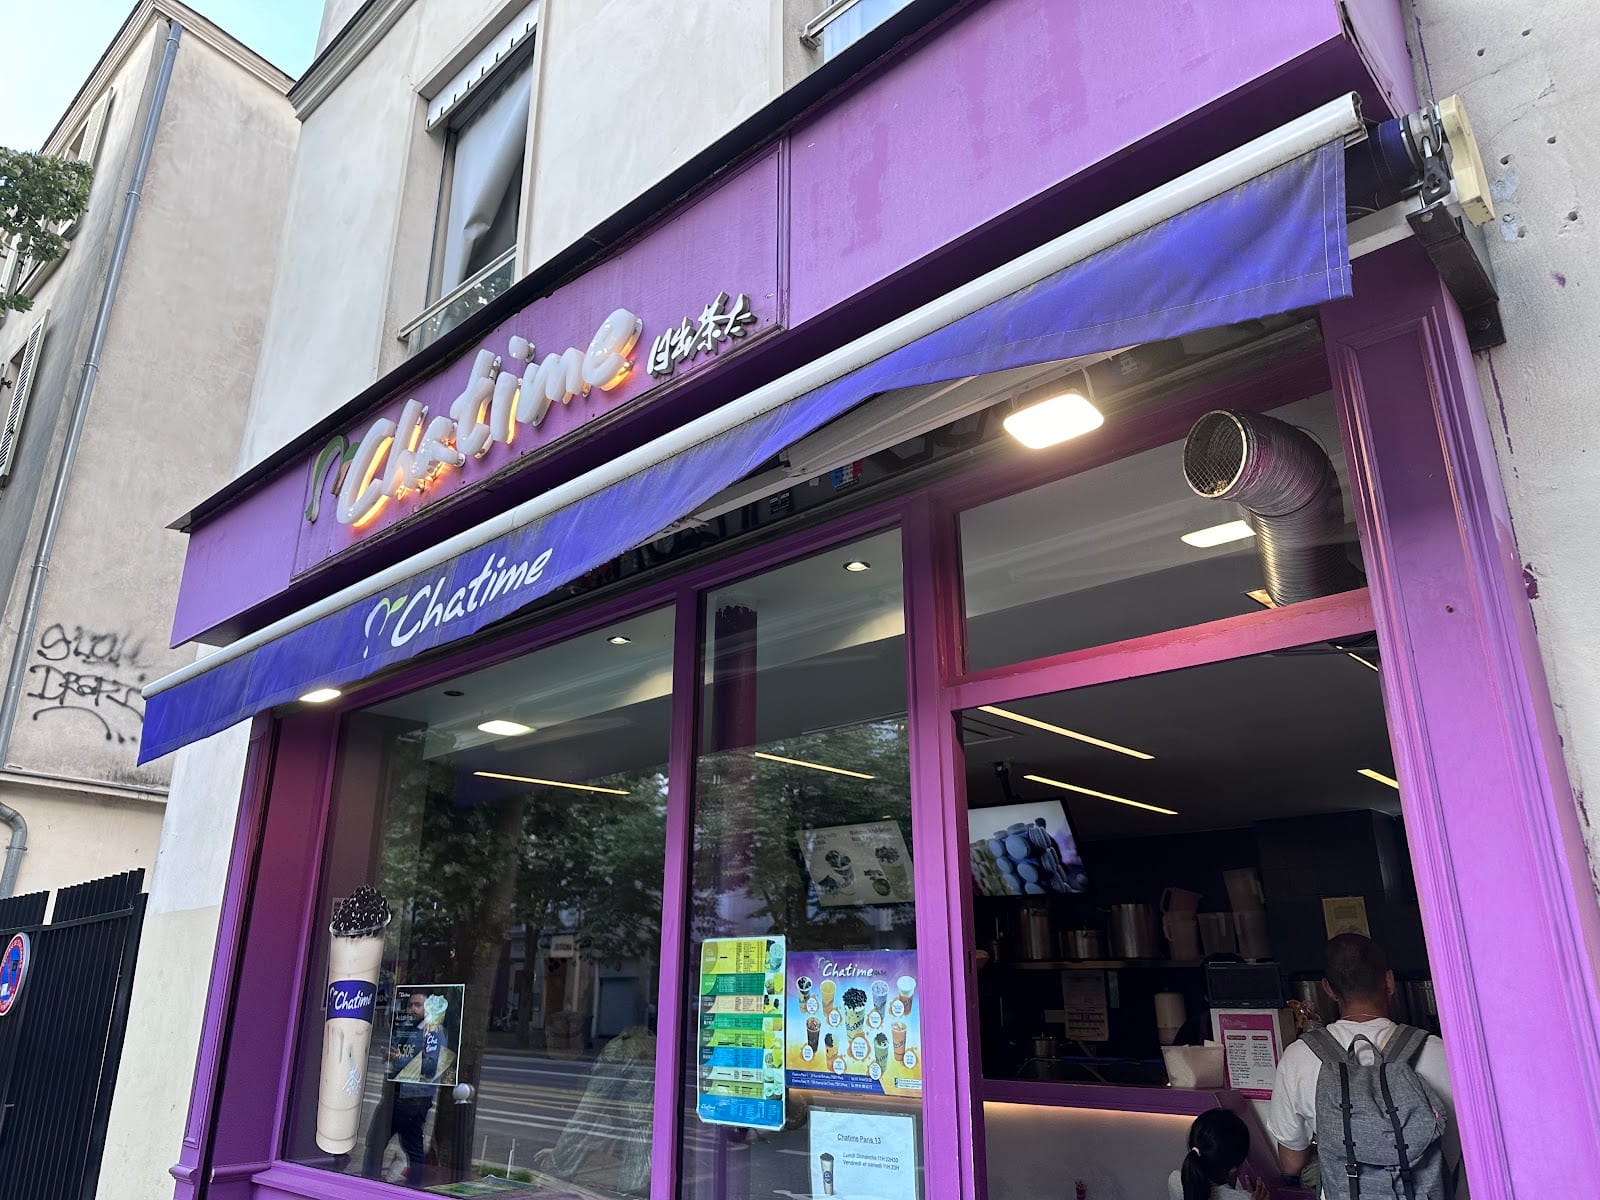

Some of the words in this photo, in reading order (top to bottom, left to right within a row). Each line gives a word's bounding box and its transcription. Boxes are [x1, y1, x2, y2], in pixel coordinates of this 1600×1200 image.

[336, 308, 642, 528] Chatime
[391, 547, 553, 648] Chatime
[822, 962, 874, 977] Chatime
[335, 989, 373, 1010] Chatime
[837, 1133, 859, 1142] Chatime
[859, 1135, 873, 1144] Paris
[874, 1137, 881, 1145] 13
